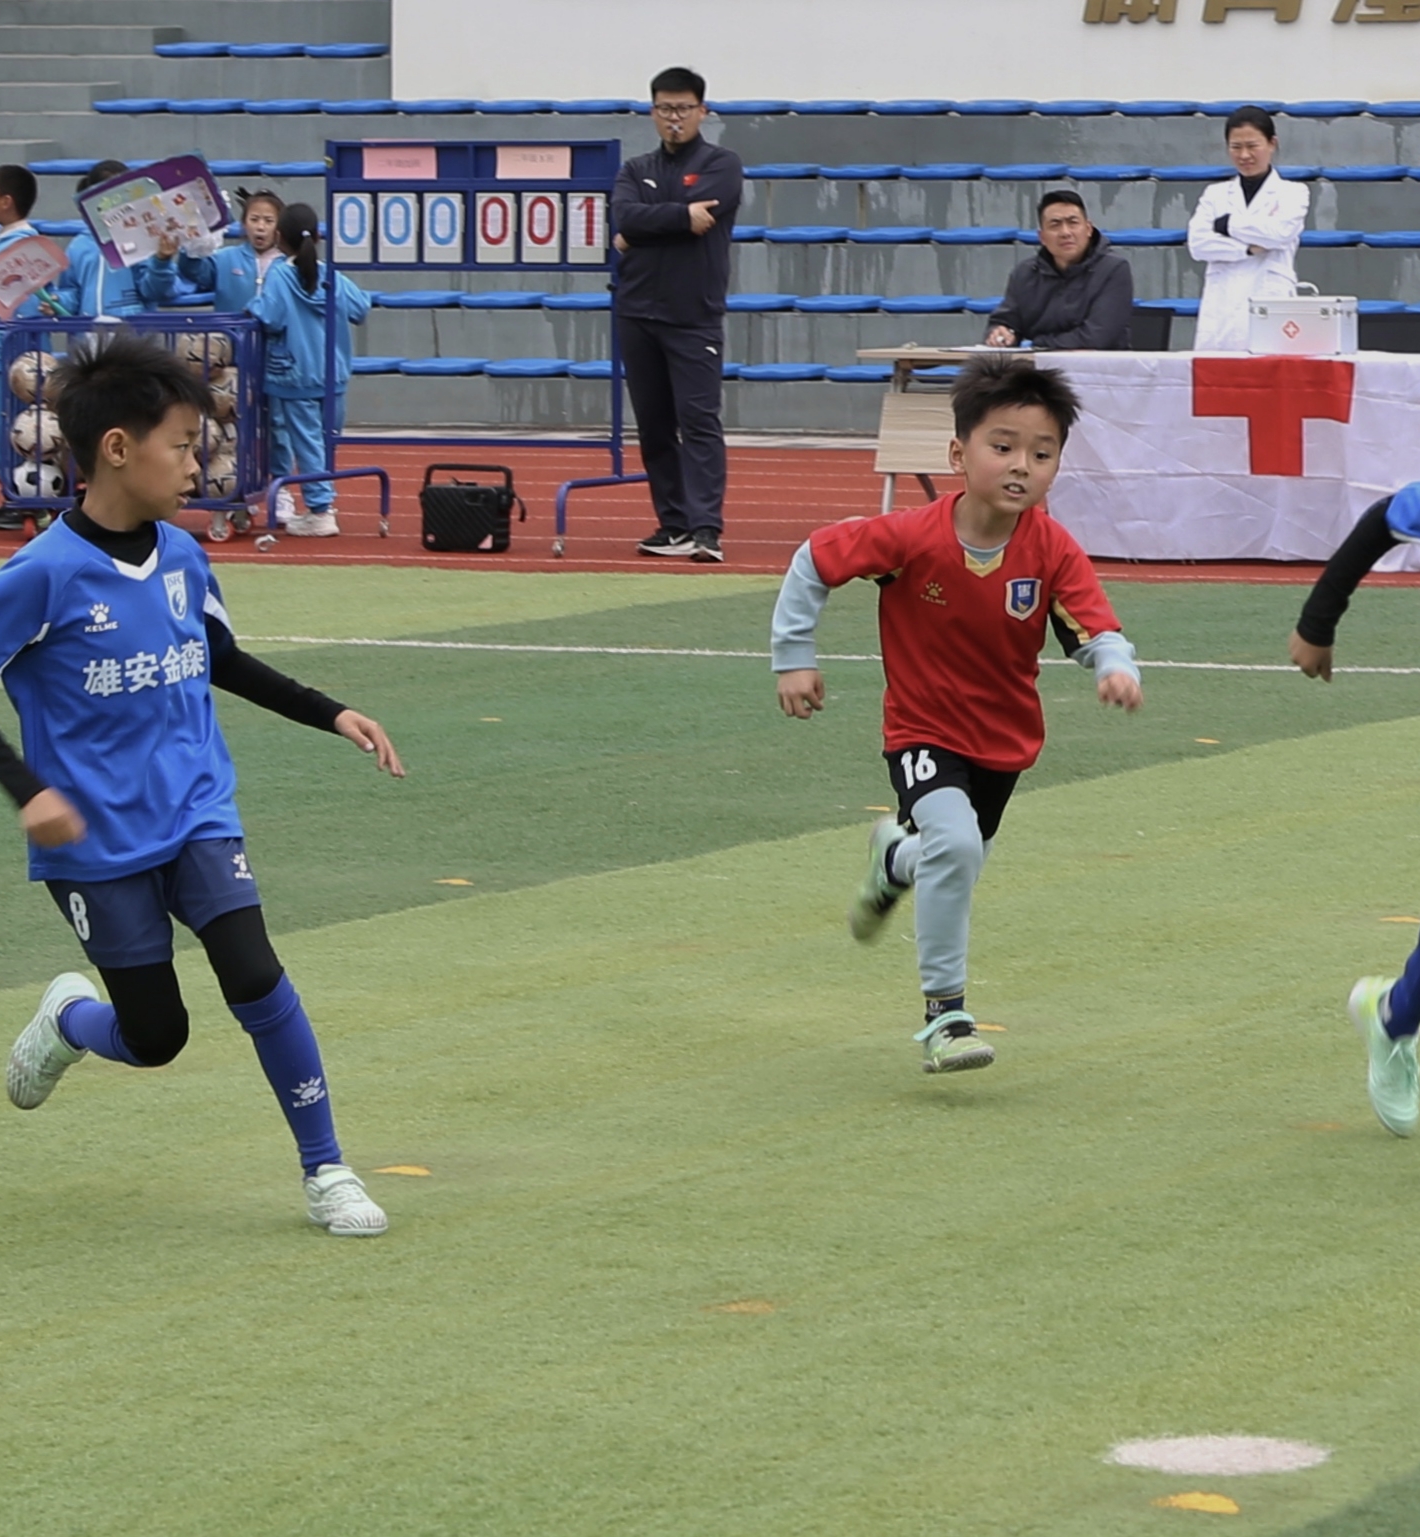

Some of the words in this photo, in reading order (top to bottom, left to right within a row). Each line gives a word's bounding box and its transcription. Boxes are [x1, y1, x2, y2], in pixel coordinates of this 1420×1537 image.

[920, 593, 948, 606] KELME
[84, 621, 119, 633] KELME
[900, 749, 938, 790] 16
[69, 891, 91, 942] 8
